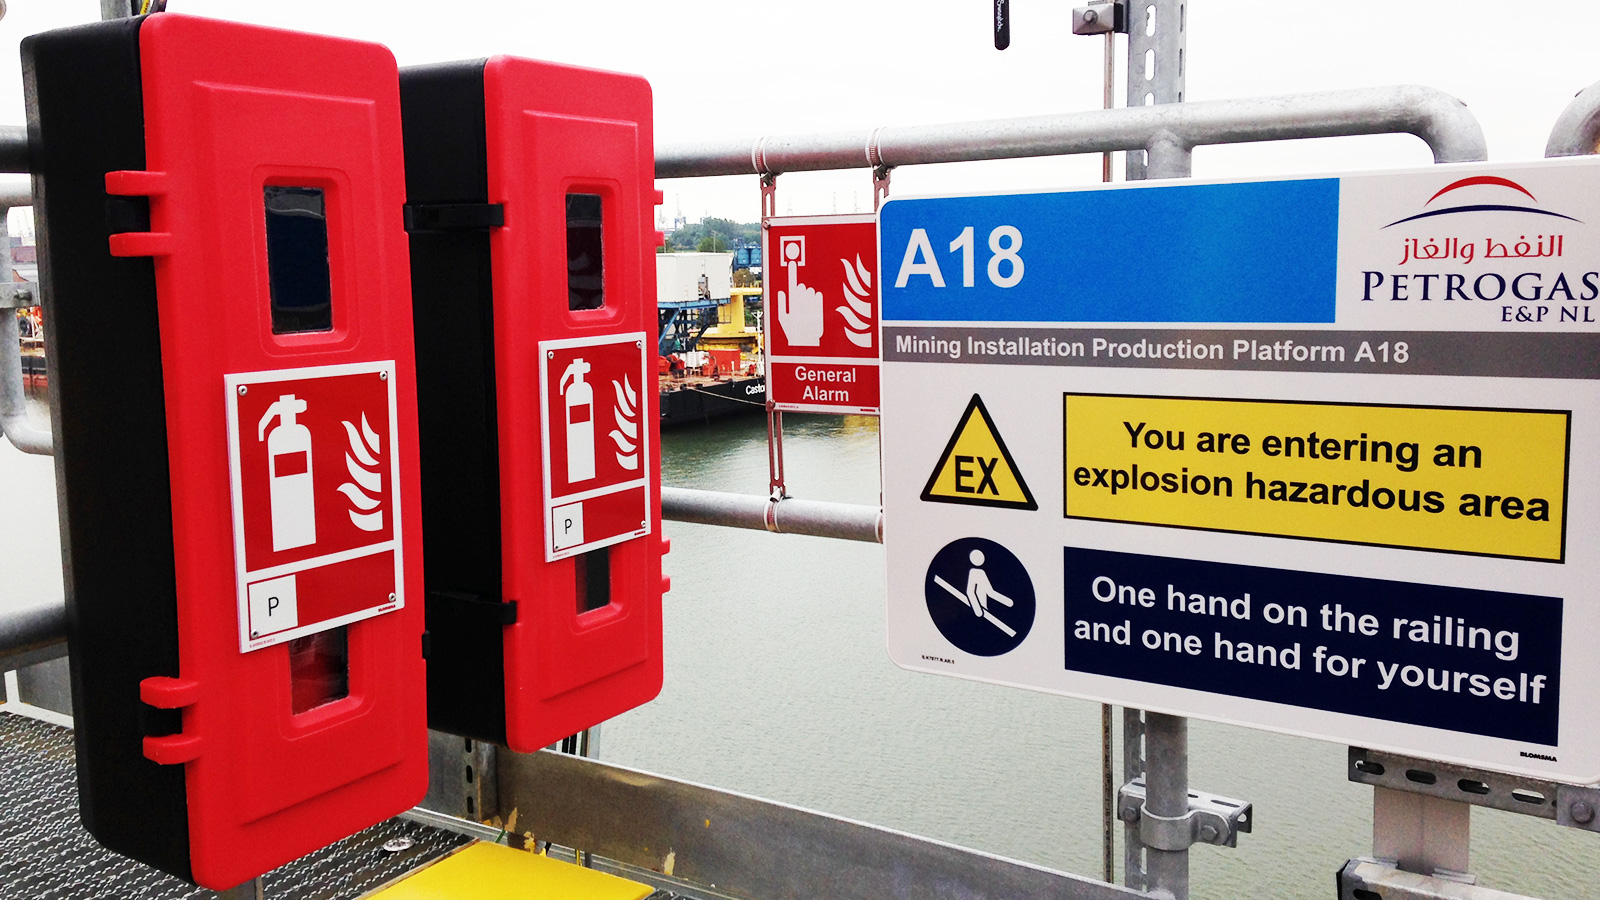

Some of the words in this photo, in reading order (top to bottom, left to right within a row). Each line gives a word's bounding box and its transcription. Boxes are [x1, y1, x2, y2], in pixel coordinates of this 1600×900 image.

[894, 225, 1025, 288] A18
[1398, 237, 1475, 265] والغاز
[1484, 234, 1563, 258] النفط
[1361, 271, 1600, 301] PETROGAS
[1501, 305, 1549, 322] E&P
[1560, 306, 1596, 322] NL
[896, 335, 961, 359] Mining
[967, 336, 1085, 357] Installation
[1092, 338, 1224, 360] Production
[1233, 339, 1345, 362] Platform
[1354, 341, 1410, 364] A18
[795, 366, 856, 383] General
[745, 384, 766, 395] Casto
[802, 385, 849, 402] Alarm
[1123, 421, 1185, 451] You
[1196, 432, 1251, 455] are
[1262, 431, 1419, 472] entering
[1433, 444, 1482, 468] an
[955, 455, 1000, 496] EX
[1073, 464, 1233, 497] explosion
[1246, 471, 1445, 514] hazardous
[1459, 493, 1550, 522] area
[564, 518, 573, 534] P
[268, 596, 280, 617] P
[1091, 576, 1156, 608] One
[1167, 584, 1251, 620] hand
[1263, 602, 1308, 627] on
[1320, 604, 1380, 636] the
[1393, 615, 1519, 661] railing
[1074, 620, 1131, 645] and
[1142, 629, 1203, 655] one
[1214, 632, 1301, 670] hand
[1313, 645, 1366, 678] for
[1376, 661, 1547, 704] yourself
[1519, 751, 1558, 762] BLOMSMA
